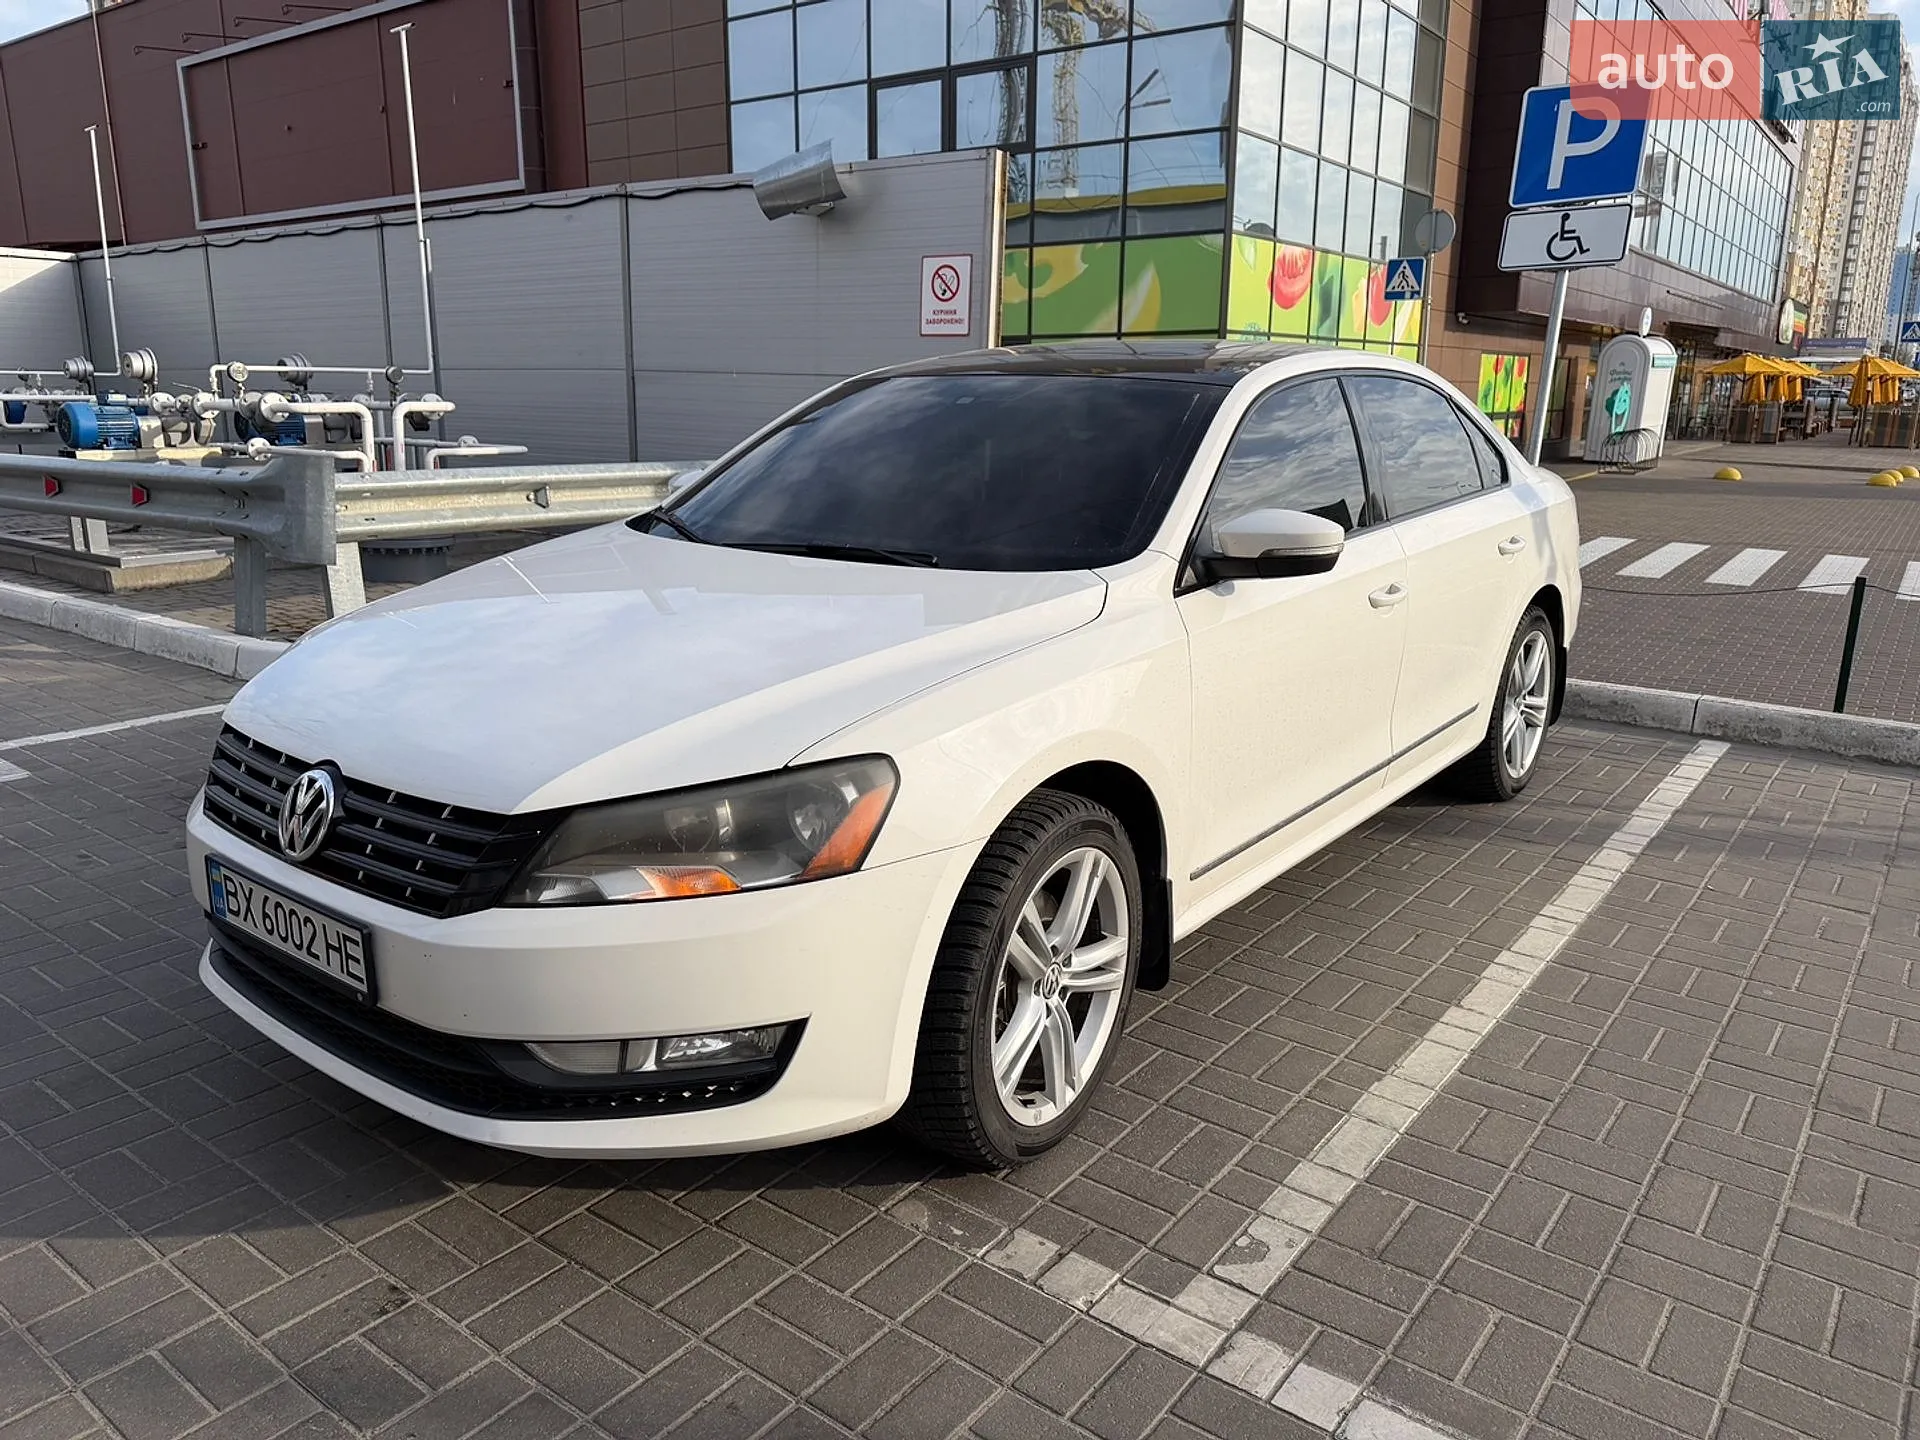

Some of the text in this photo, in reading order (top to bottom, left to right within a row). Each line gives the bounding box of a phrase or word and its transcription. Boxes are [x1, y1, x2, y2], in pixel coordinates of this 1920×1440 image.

[1546, 97, 1621, 190] P
[223, 874, 365, 985] BX 6002 HE
